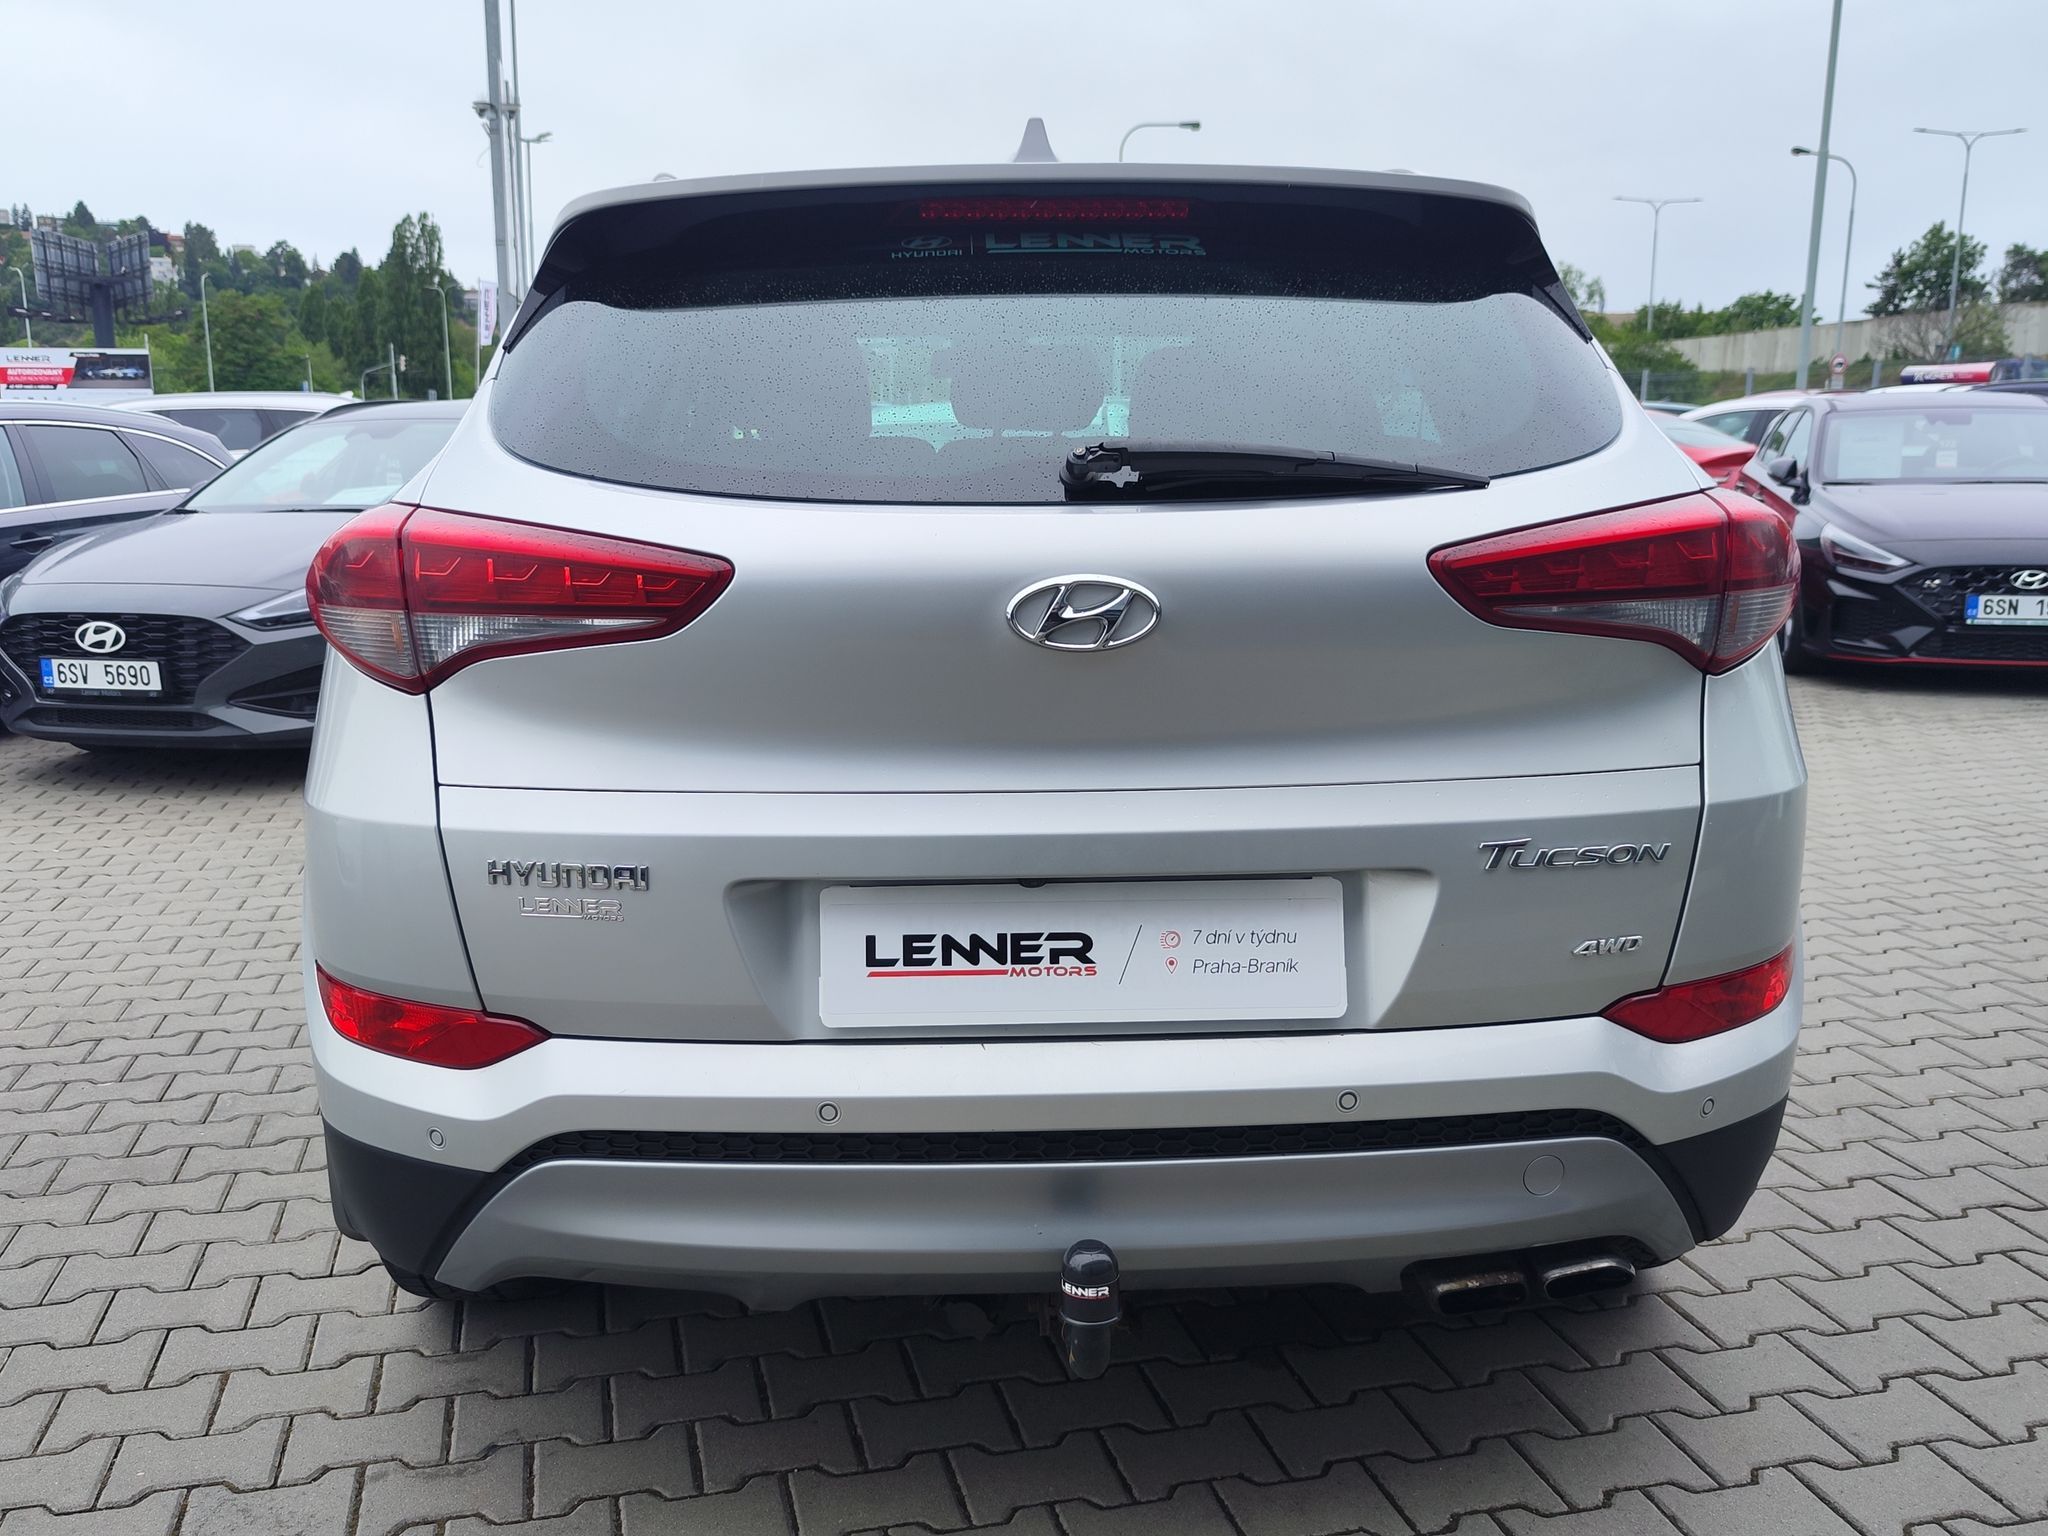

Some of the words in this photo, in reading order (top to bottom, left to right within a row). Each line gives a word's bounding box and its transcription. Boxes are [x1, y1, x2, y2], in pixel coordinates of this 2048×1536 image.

[984, 232, 1201, 250] LENNER
[891, 249, 963, 258] HYUNDAI
[1123, 247, 1207, 256] MOTORS
[6, 354, 51, 363] LENNER
[1983, 598, 2019, 616] 6SN
[57, 662, 88, 685] 6SV
[104, 664, 151, 686] 5690
[487, 858, 650, 892] HYUNDAI
[518, 896, 623, 915] LENNER
[581, 913, 625, 922] MOTORS
[1192, 929, 1202, 945] 7
[1205, 929, 1233, 945] dní
[1235, 932, 1246, 945] v
[1250, 928, 1298, 948] týdnu
[1571, 934, 1643, 956] 4WD
[865, 932, 1097, 967] LENNER
[1009, 965, 1098, 978] MOTORS
[1192, 957, 1300, 974] Praha-Braník
[1061, 1278, 1110, 1297] LENNER
